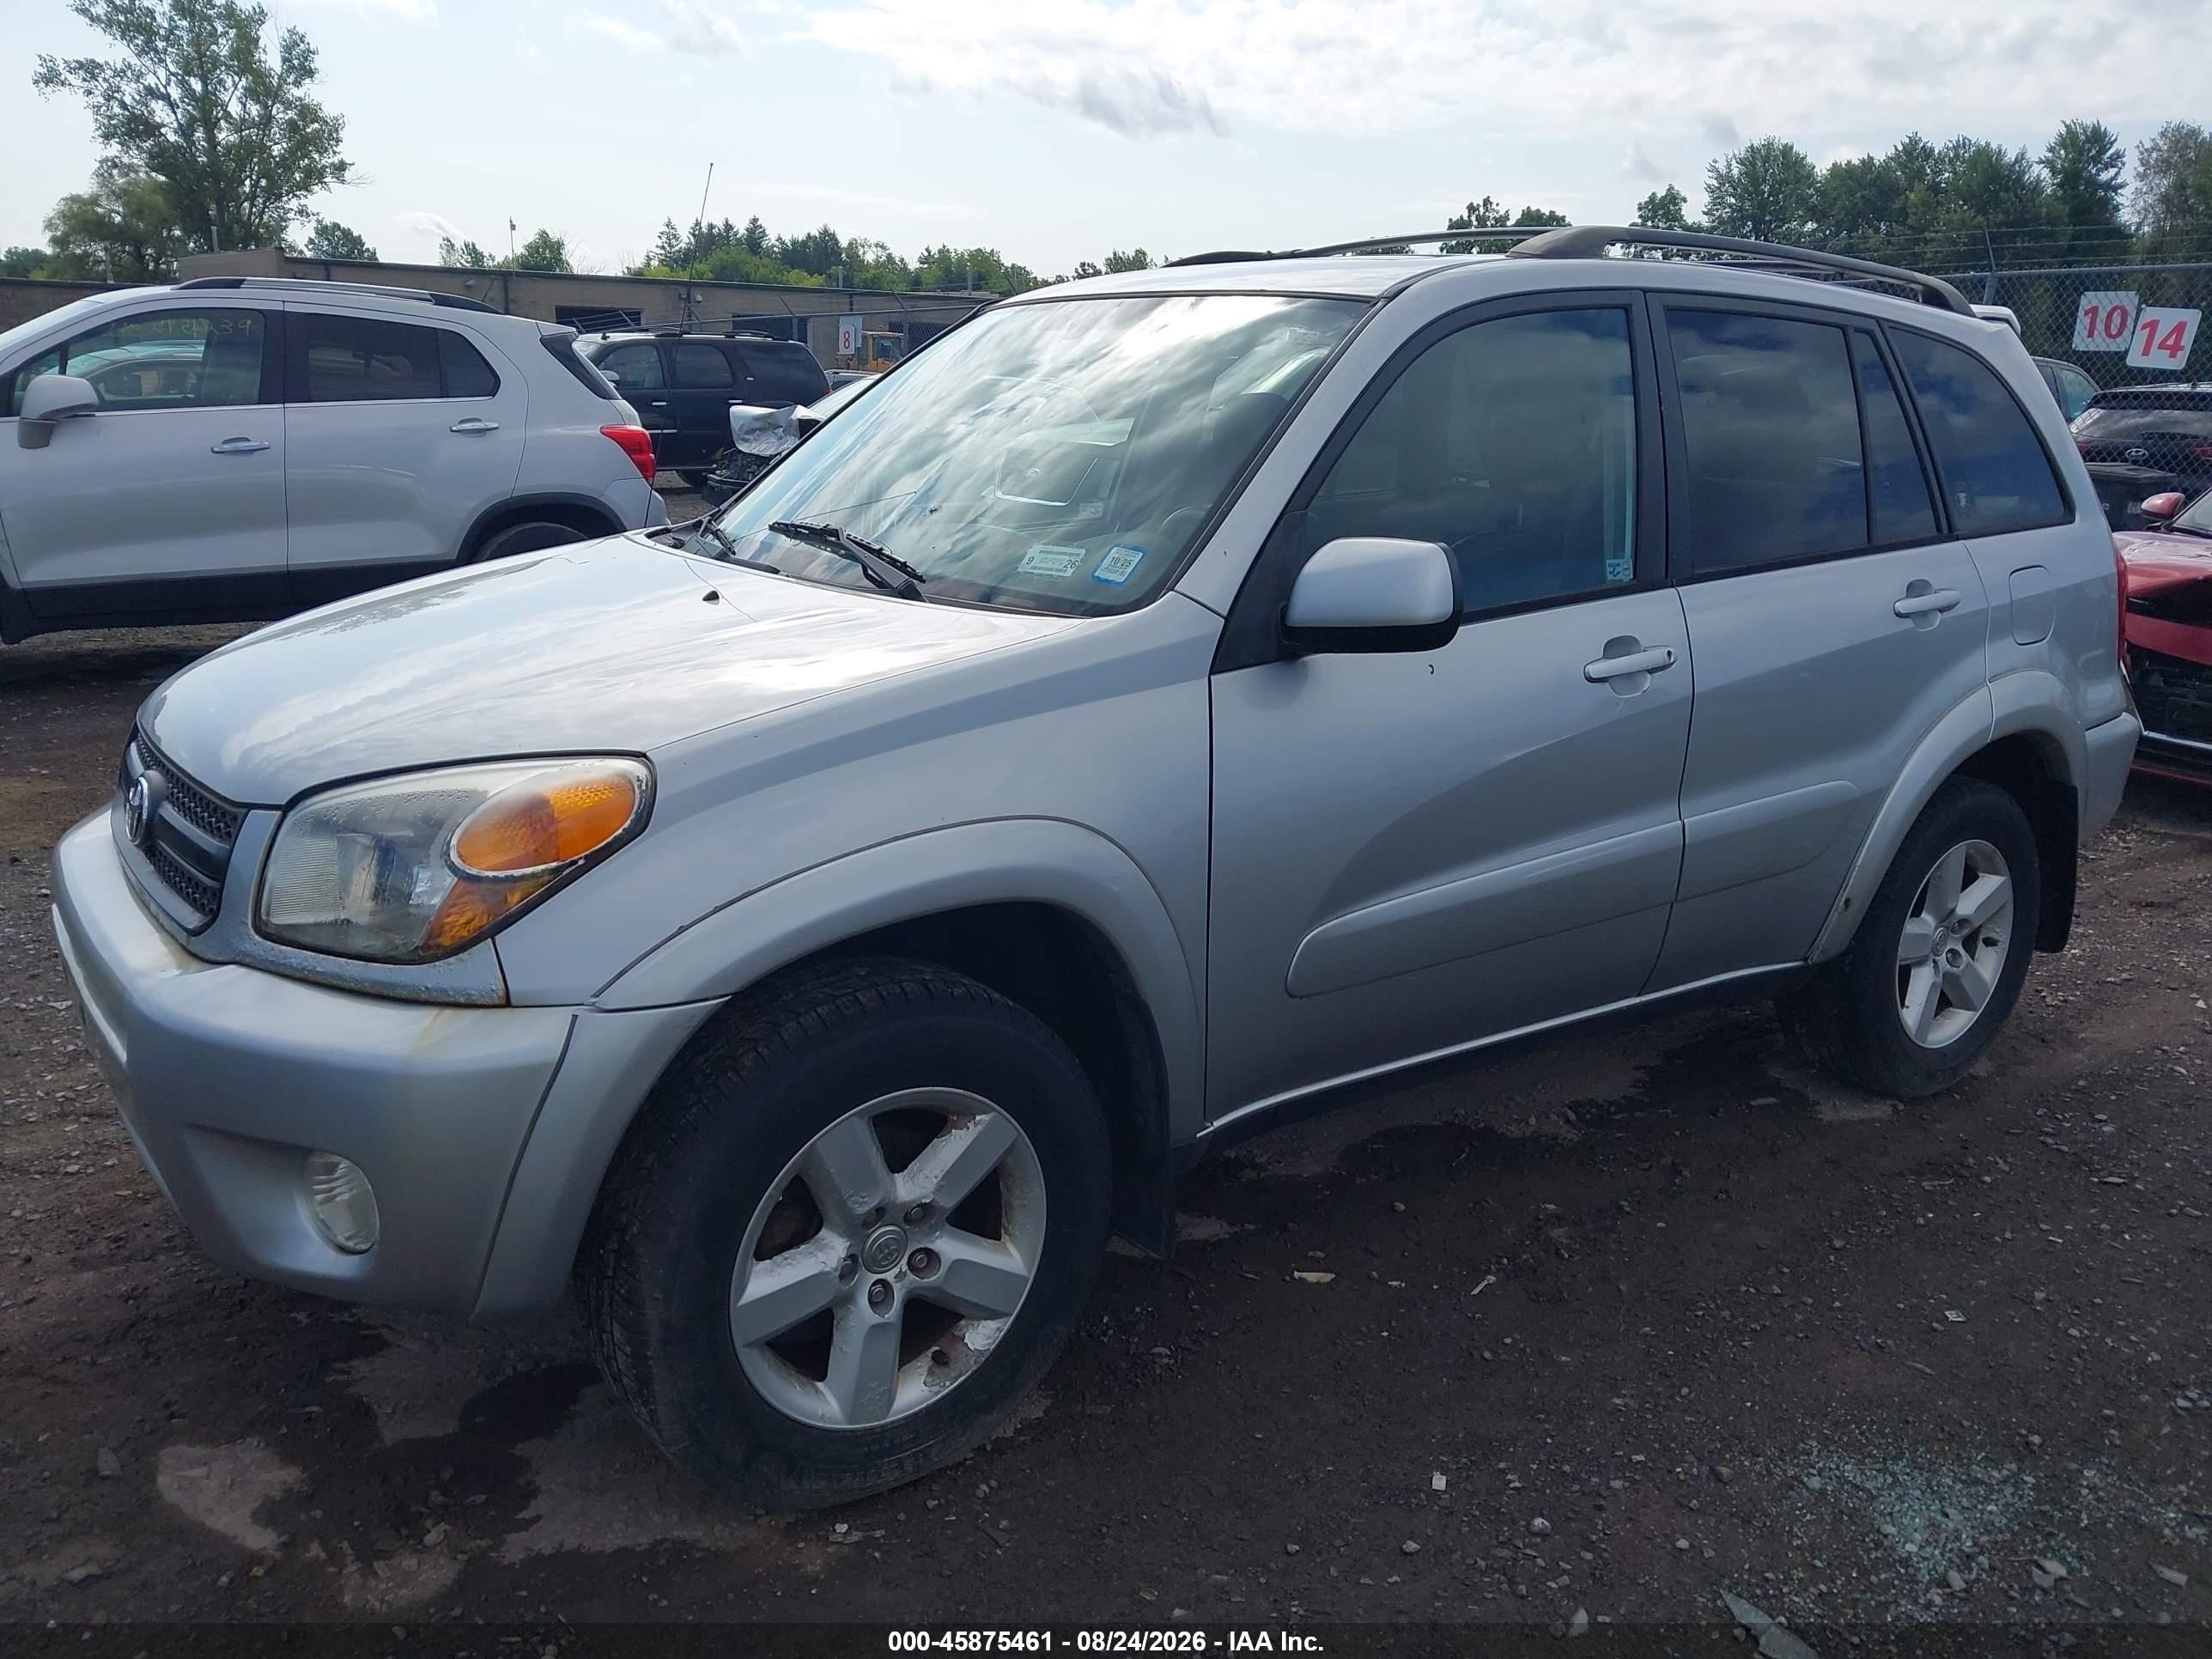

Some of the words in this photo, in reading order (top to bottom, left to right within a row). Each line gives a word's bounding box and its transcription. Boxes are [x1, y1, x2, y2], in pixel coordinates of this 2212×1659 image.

[2083, 305, 2129, 339] 10
[843, 330, 850, 349] 8
[2140, 319, 2188, 358] 14
[1026, 556, 1035, 565] 9
[1063, 559, 1079, 569] 26
